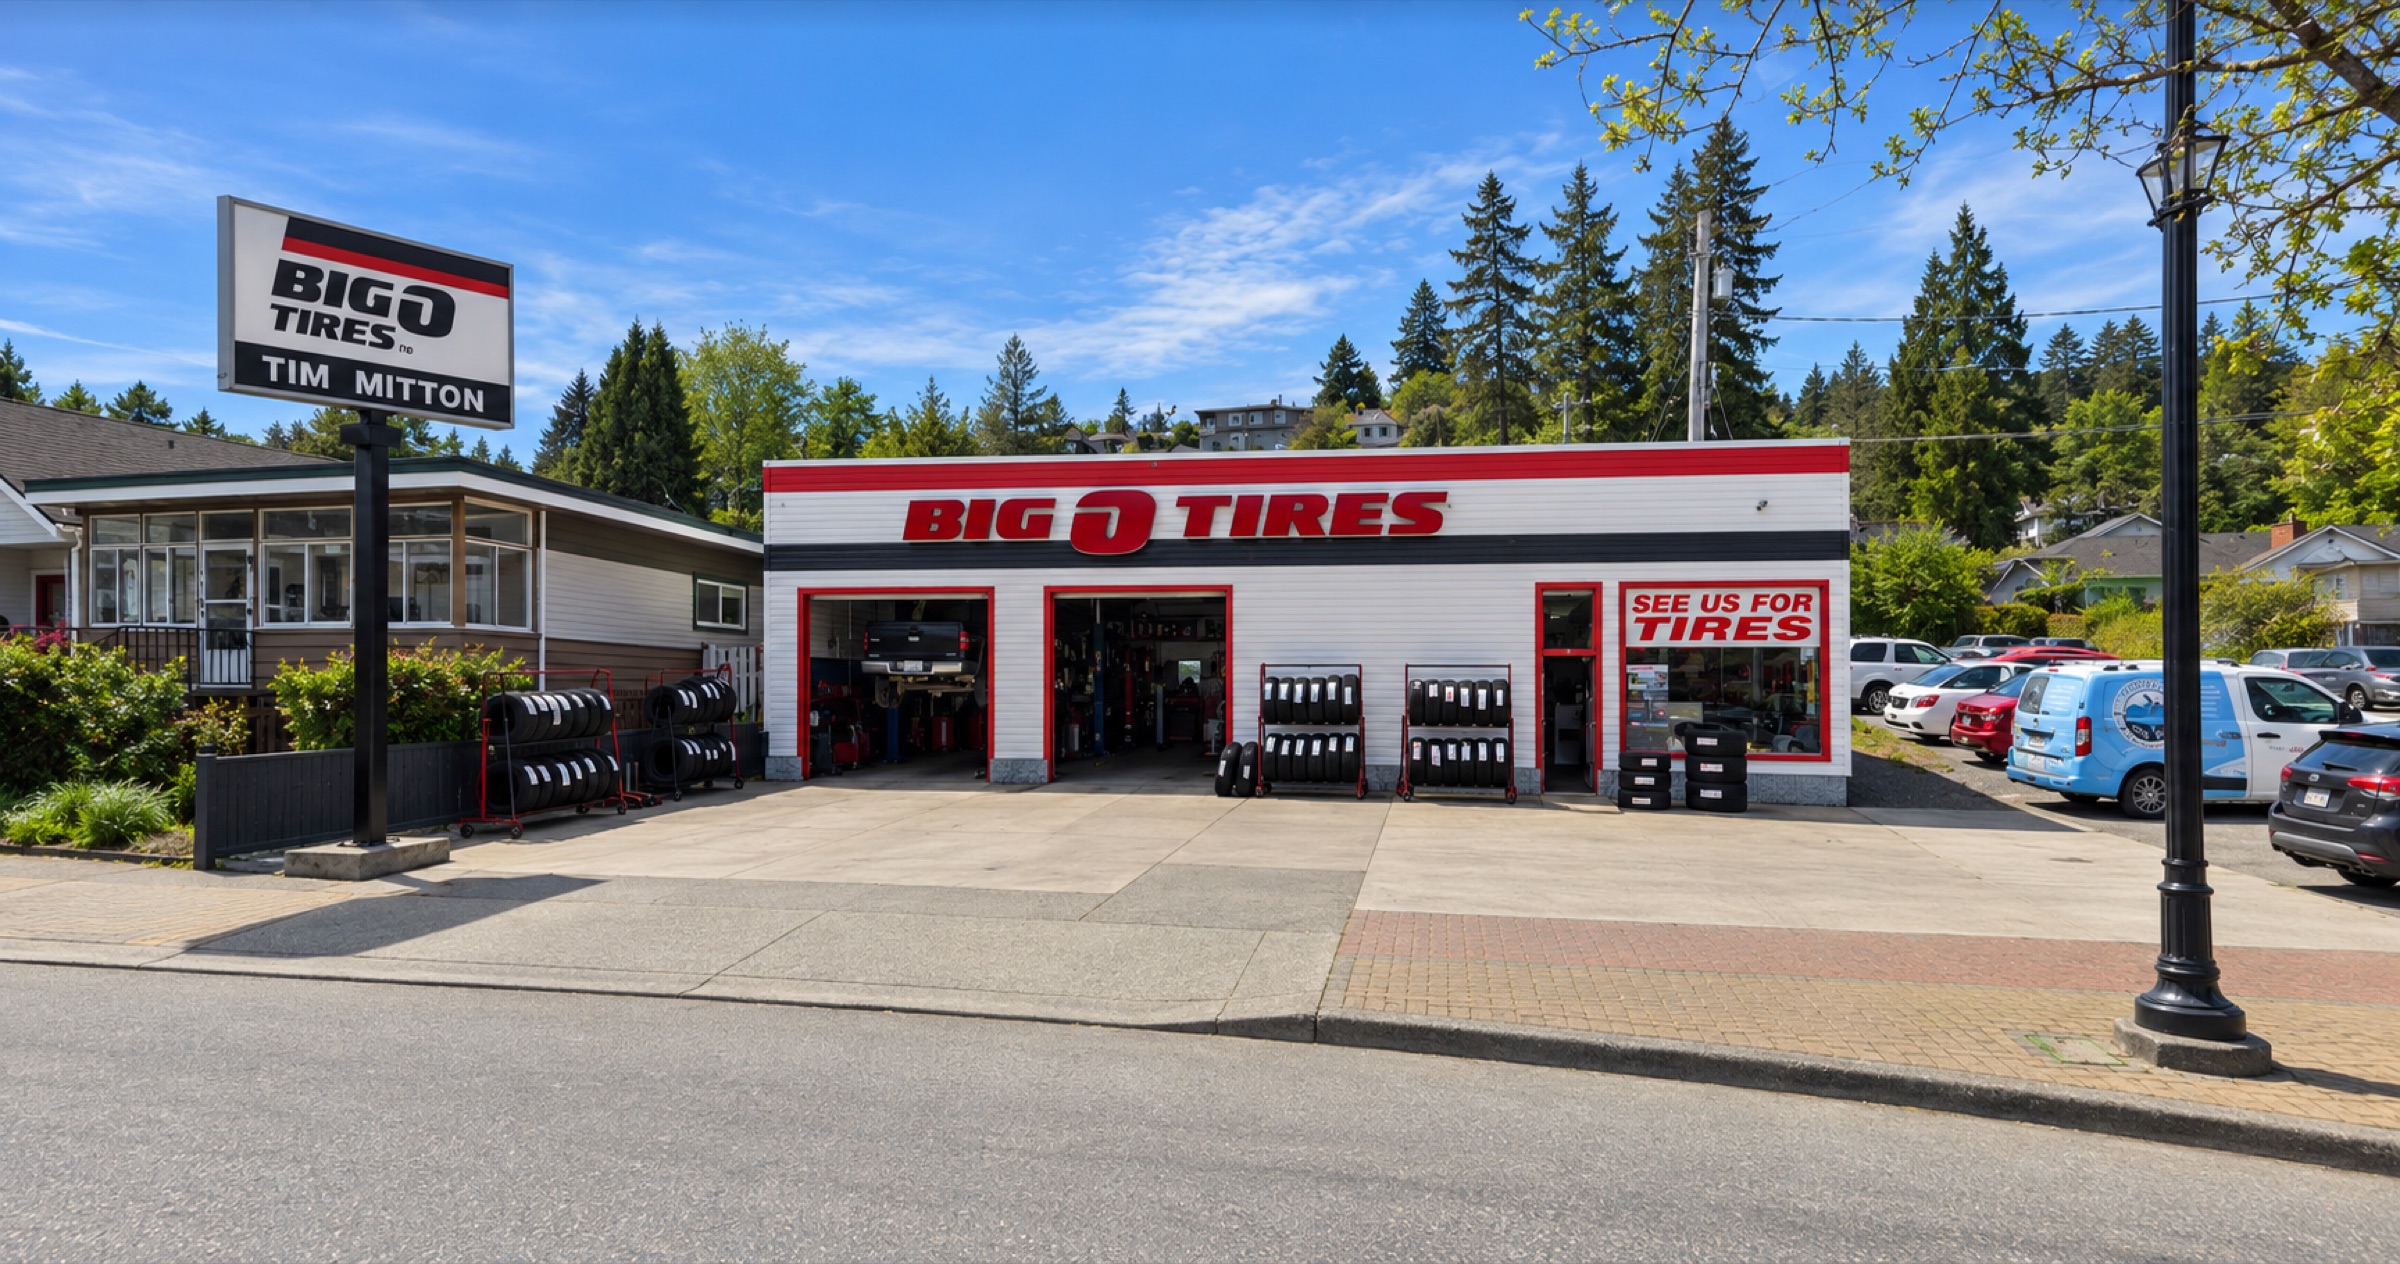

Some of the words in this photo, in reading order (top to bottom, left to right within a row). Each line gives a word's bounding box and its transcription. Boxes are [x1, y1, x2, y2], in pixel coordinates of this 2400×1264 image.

[271, 258, 395, 318] BIG
[397, 284, 456, 338] O
[270, 302, 397, 351] TIRES
[262, 355, 330, 389] TIM
[356, 370, 485, 413] MITTON
[902, 498, 1056, 541] BIG
[1070, 489, 1156, 555] O
[1176, 491, 1448, 538] TIRES
[1632, 594, 1691, 614] SEE
[1700, 593, 1740, 613] US
[1750, 593, 1813, 613] FOR
[1634, 615, 1813, 642] TIRES
